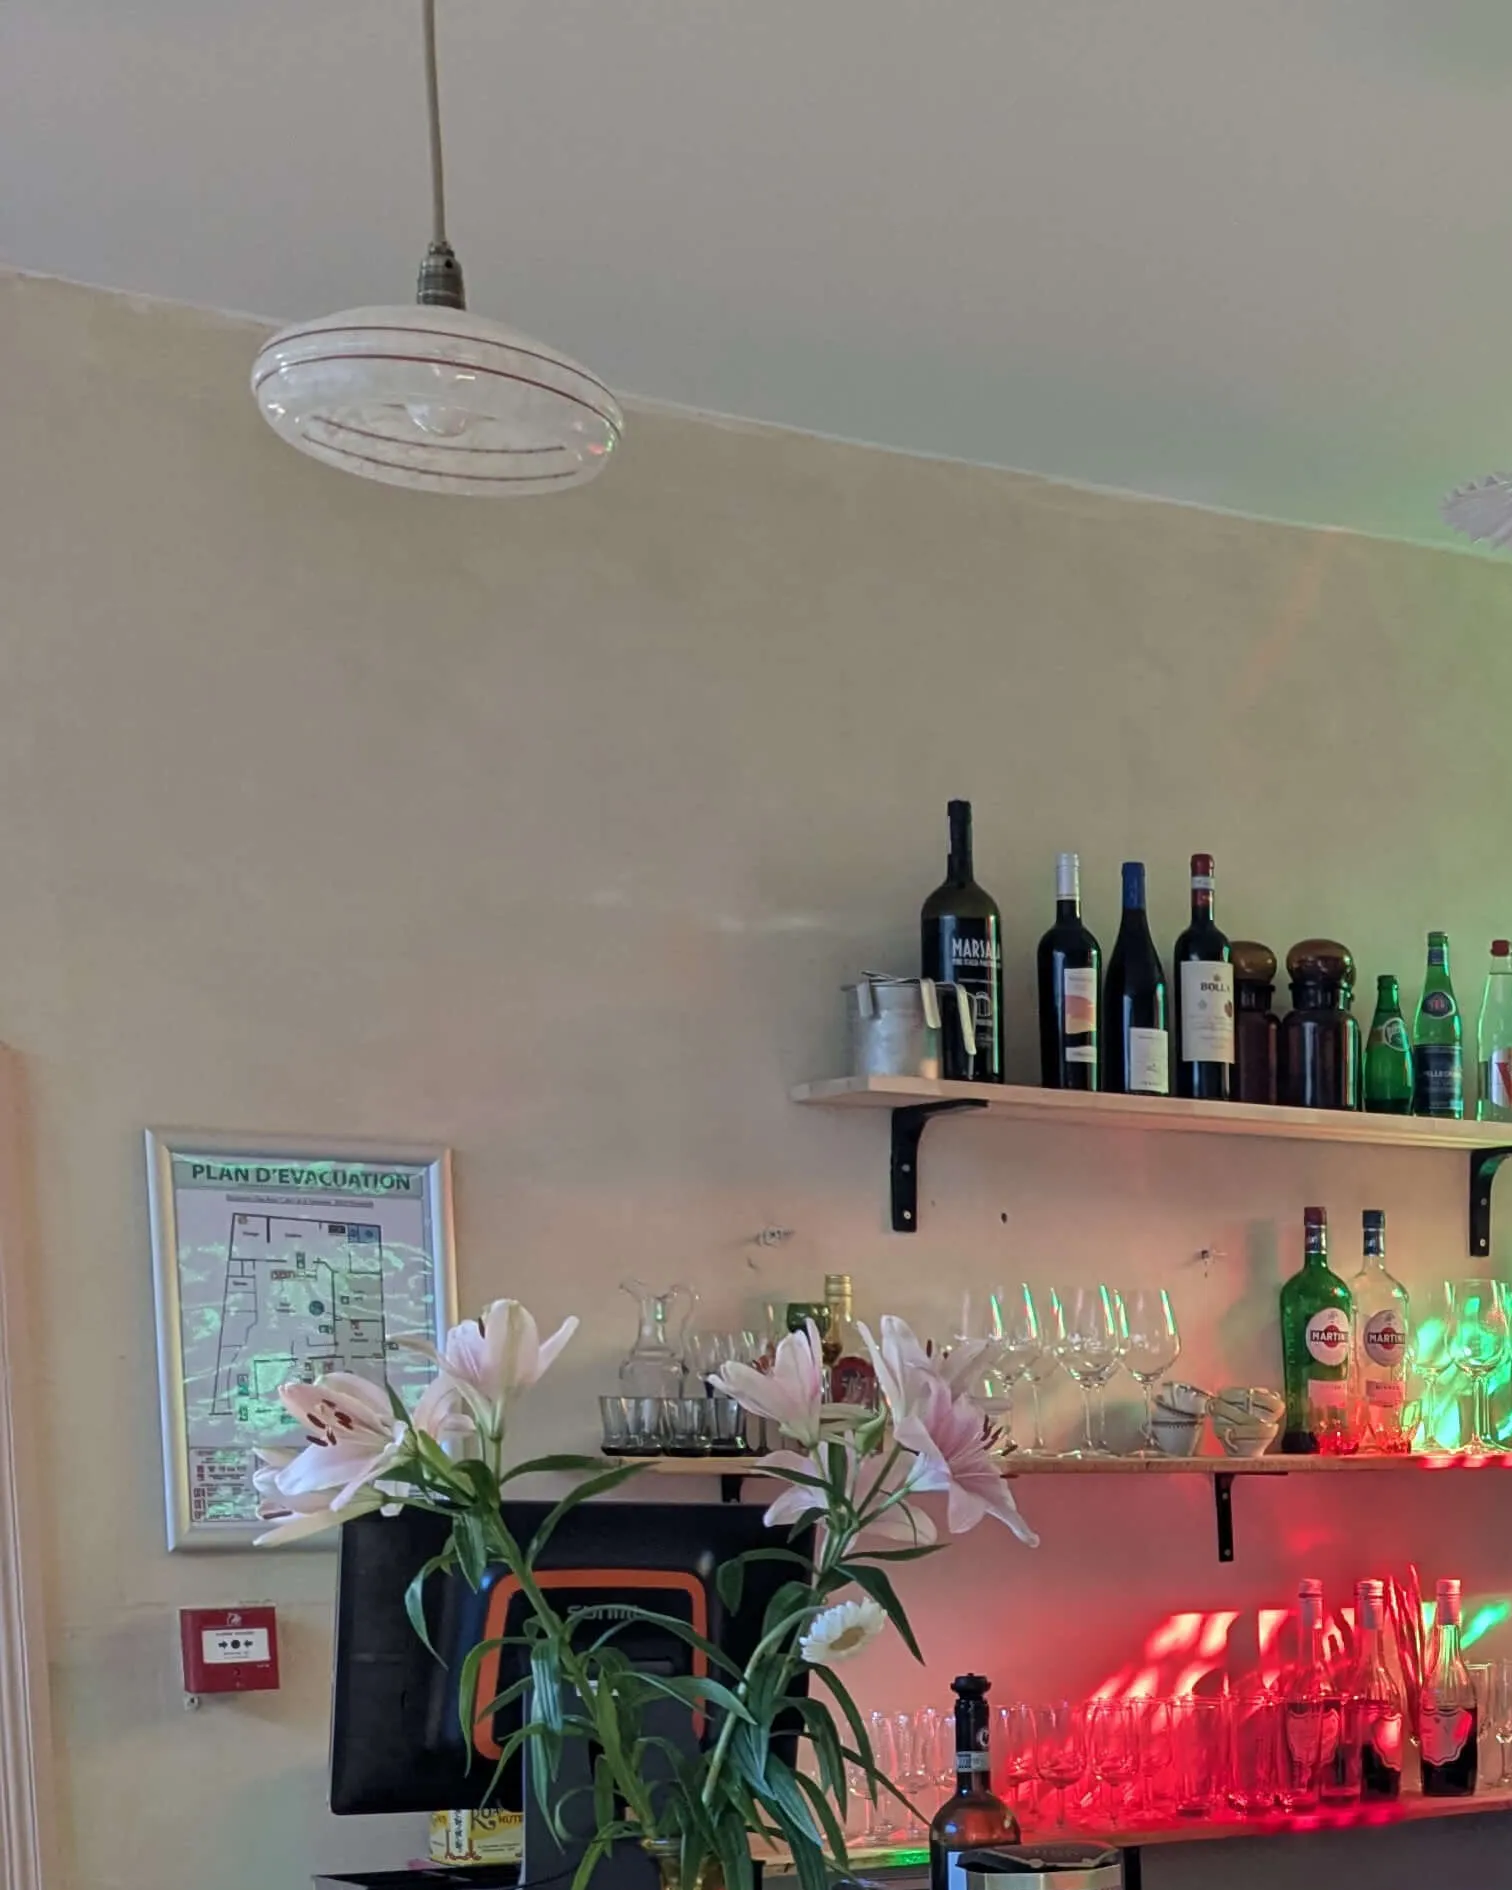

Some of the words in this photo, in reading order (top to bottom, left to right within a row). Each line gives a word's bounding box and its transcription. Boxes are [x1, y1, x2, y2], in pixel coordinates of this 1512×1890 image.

[192, 1164, 249, 1182] PLAN
[256, 1166, 411, 1190] D'EVACUATION
[1312, 1331, 1346, 1341] MARTIN
